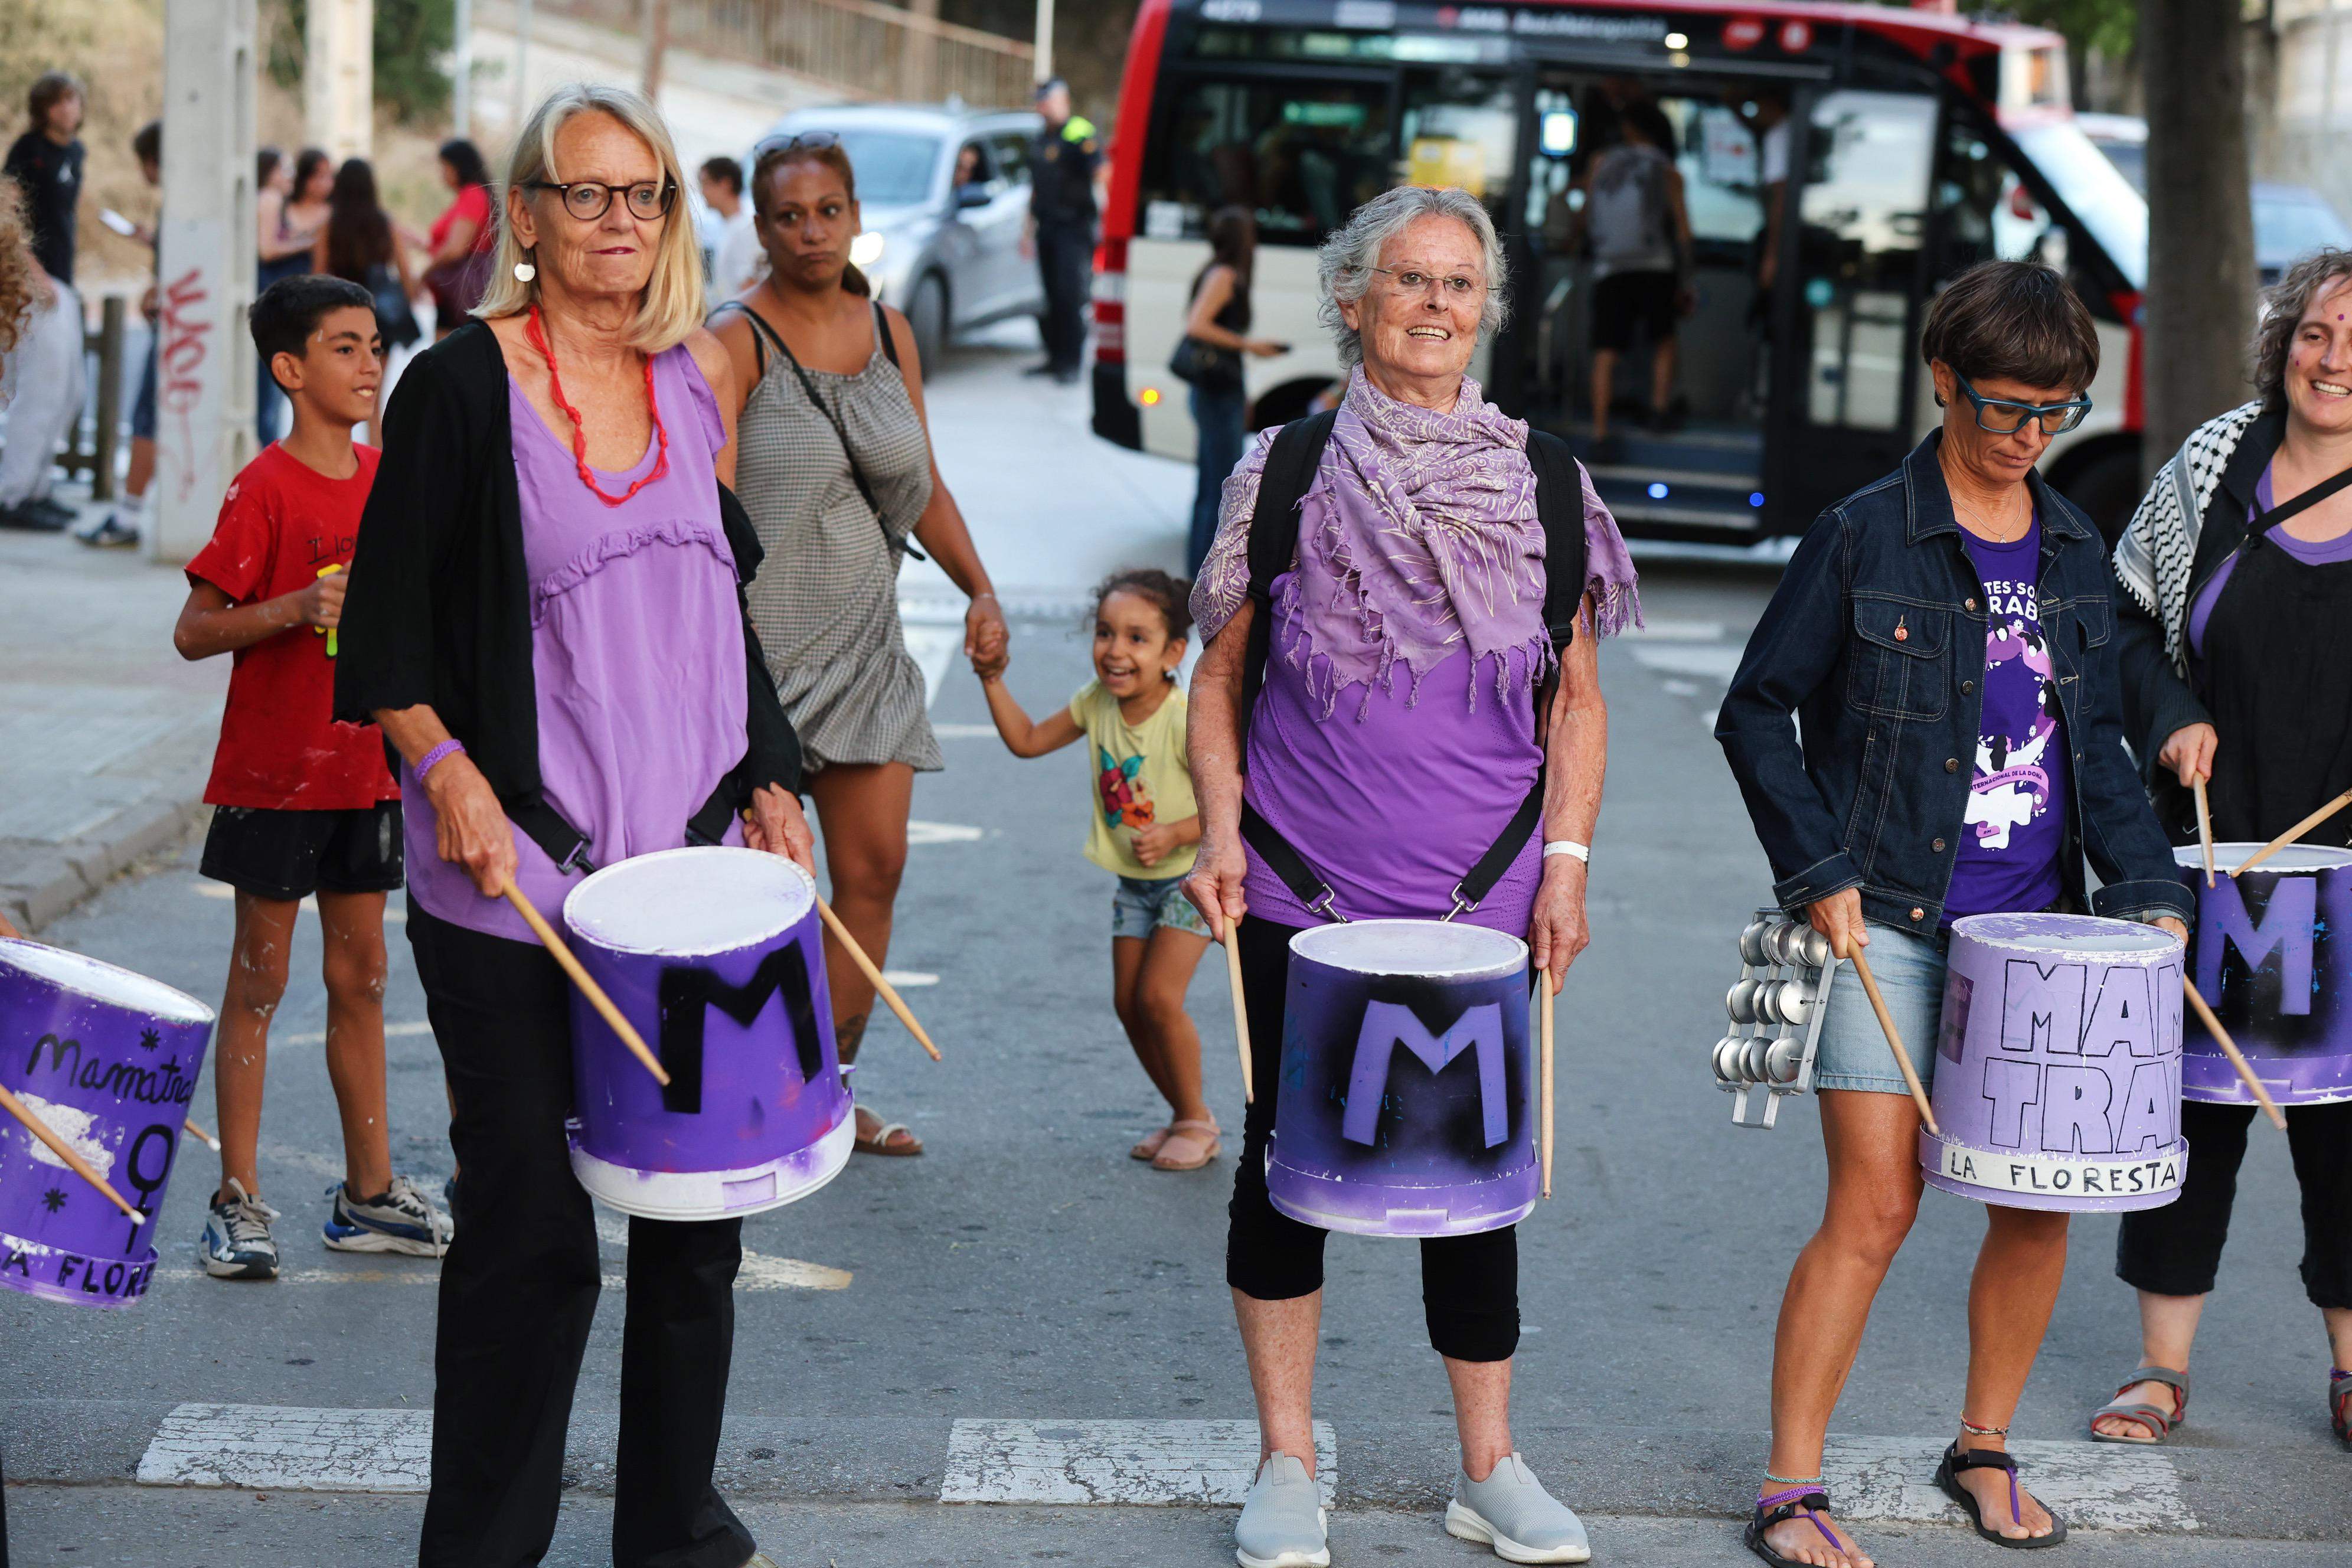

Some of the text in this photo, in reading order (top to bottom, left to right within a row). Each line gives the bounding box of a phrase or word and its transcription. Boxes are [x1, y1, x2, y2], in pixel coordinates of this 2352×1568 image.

[1984, 581, 2037, 602] TES SO
[1989, 596, 2038, 621] RAB
[2028, 771, 2042, 780] DONA
[2196, 873, 2317, 1015] M
[657, 937, 823, 1114] M
[1342, 999, 1508, 1148] M
[1982, 1054, 2182, 1154] TRA
[1951, 1152, 2177, 1193] LA FLORESTA
[0, 1250, 29, 1277] A
